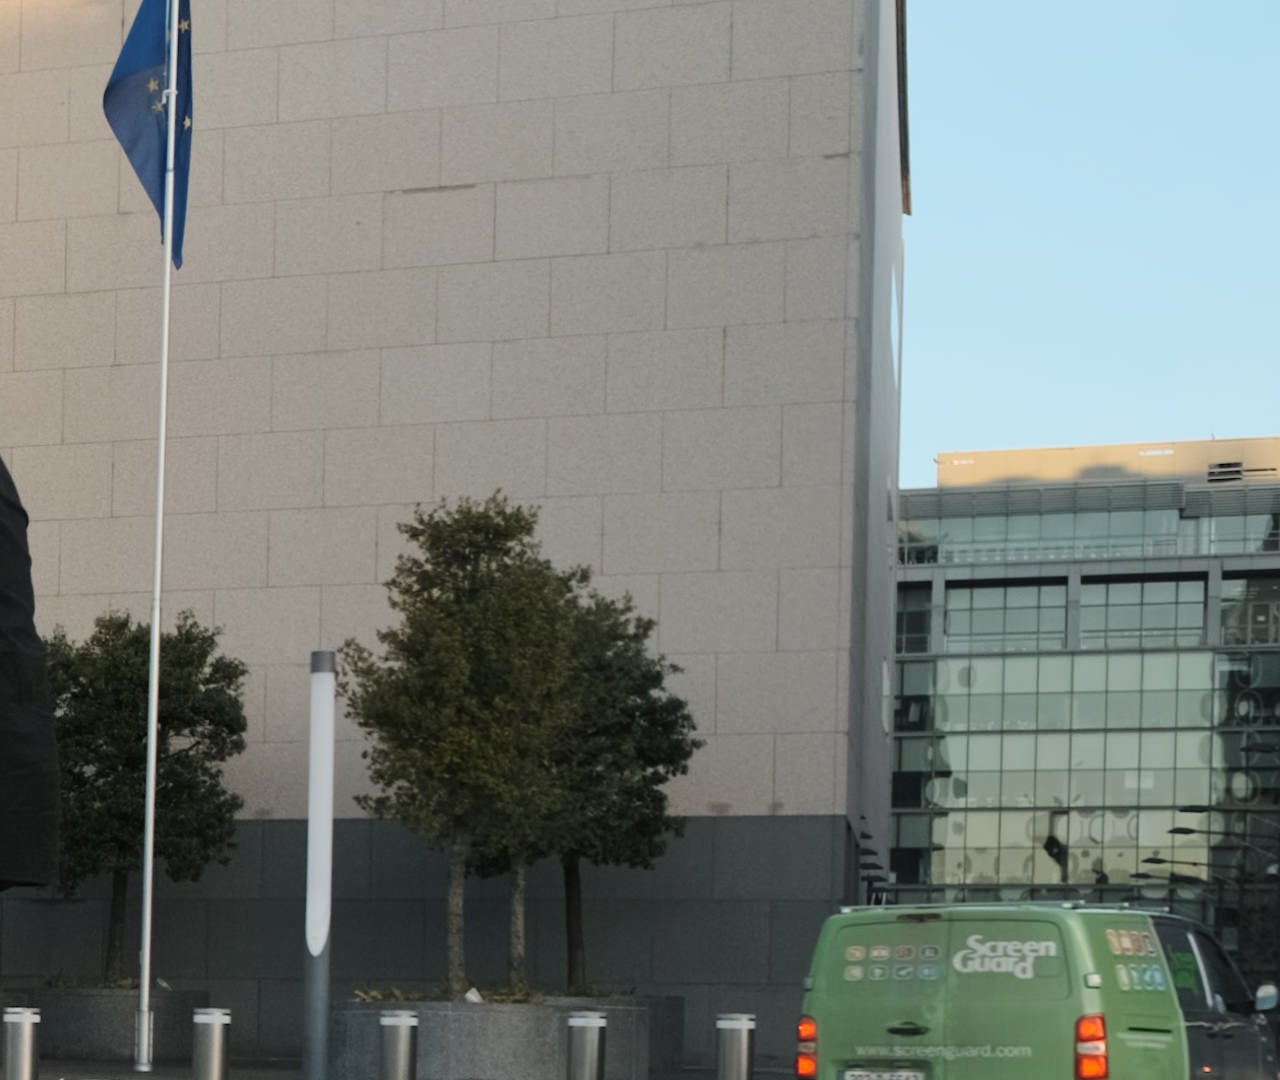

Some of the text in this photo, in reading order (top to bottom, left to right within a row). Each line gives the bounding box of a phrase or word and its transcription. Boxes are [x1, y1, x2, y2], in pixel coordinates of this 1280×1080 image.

[965, 933, 1057, 957] Screen
[952, 949, 1035, 980] Guard
[855, 1044, 1033, 1060] www.screenguard.com
